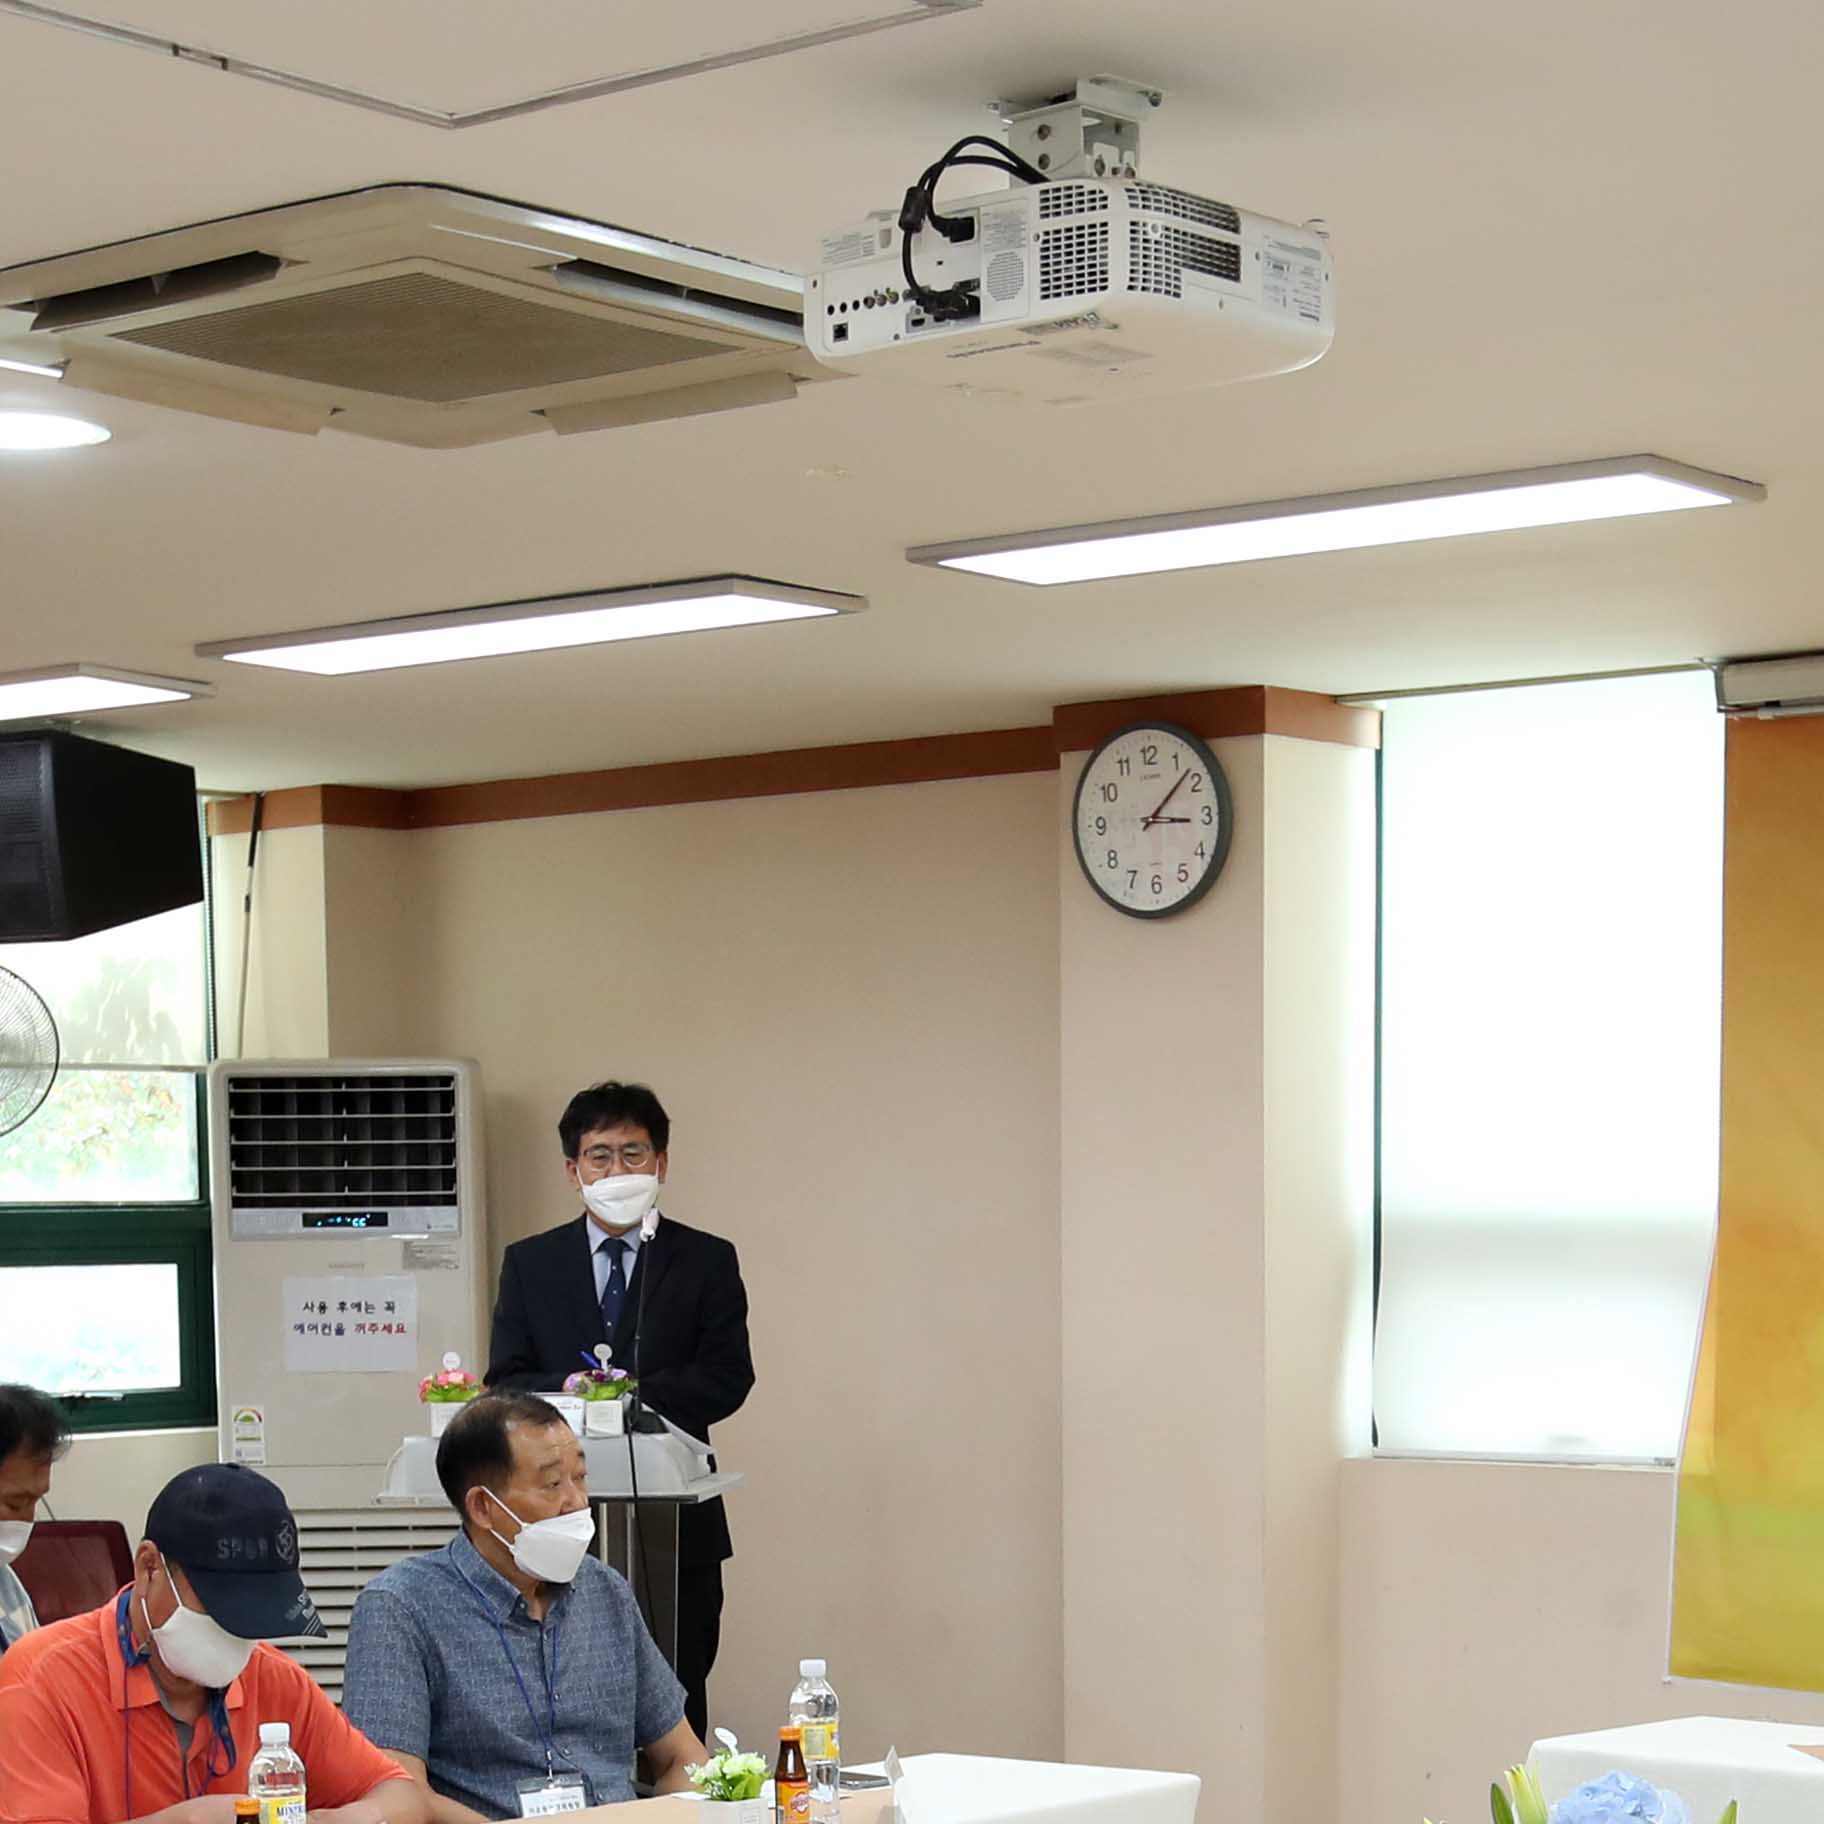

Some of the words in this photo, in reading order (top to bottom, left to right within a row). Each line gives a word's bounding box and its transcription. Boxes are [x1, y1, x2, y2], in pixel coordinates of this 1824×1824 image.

[1140, 745, 1158, 766] 12
[1172, 754, 1180, 770] 1
[1117, 757, 1131, 776] 11
[1190, 772, 1202, 792] 2
[1101, 782, 1118, 803] 10
[1201, 805, 1213, 825] 3
[1095, 816, 1107, 836] 9
[1106, 849, 1119, 869] 8
[1194, 841, 1206, 860] 4
[1127, 869, 1139, 889] 7
[1177, 863, 1190, 883] 5
[1151, 874, 1162, 894] 6
[302, 1300, 328, 1315] 사용
[336, 1300, 376, 1315] 후에는
[293, 1322, 345, 1337] 에어컨을
[354, 1321, 407, 1336] 꺼주세요
